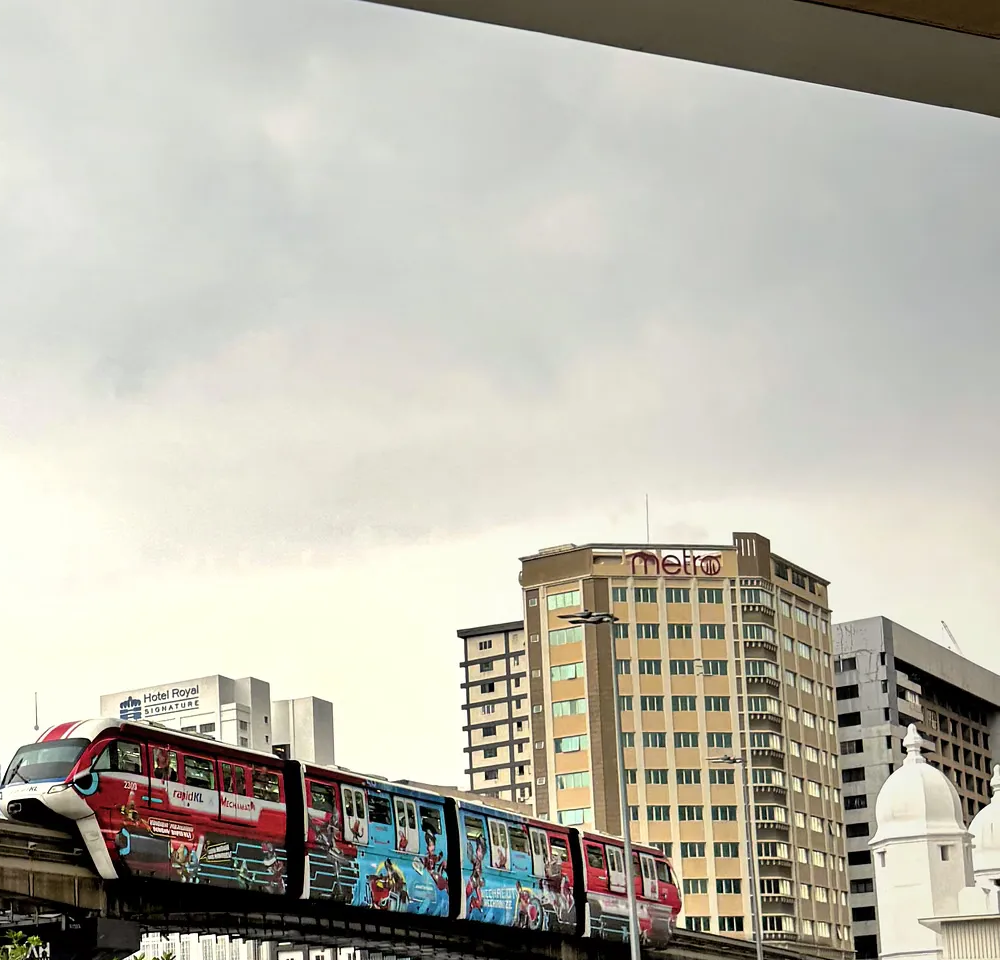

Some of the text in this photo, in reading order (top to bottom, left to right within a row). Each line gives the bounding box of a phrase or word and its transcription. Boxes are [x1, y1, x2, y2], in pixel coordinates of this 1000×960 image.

[626, 549, 721, 576] metro
[143, 685, 199, 703] Hotel Royal
[145, 700, 200, 715] SIGNATURE
[172, 790, 204, 803] rapidKL
